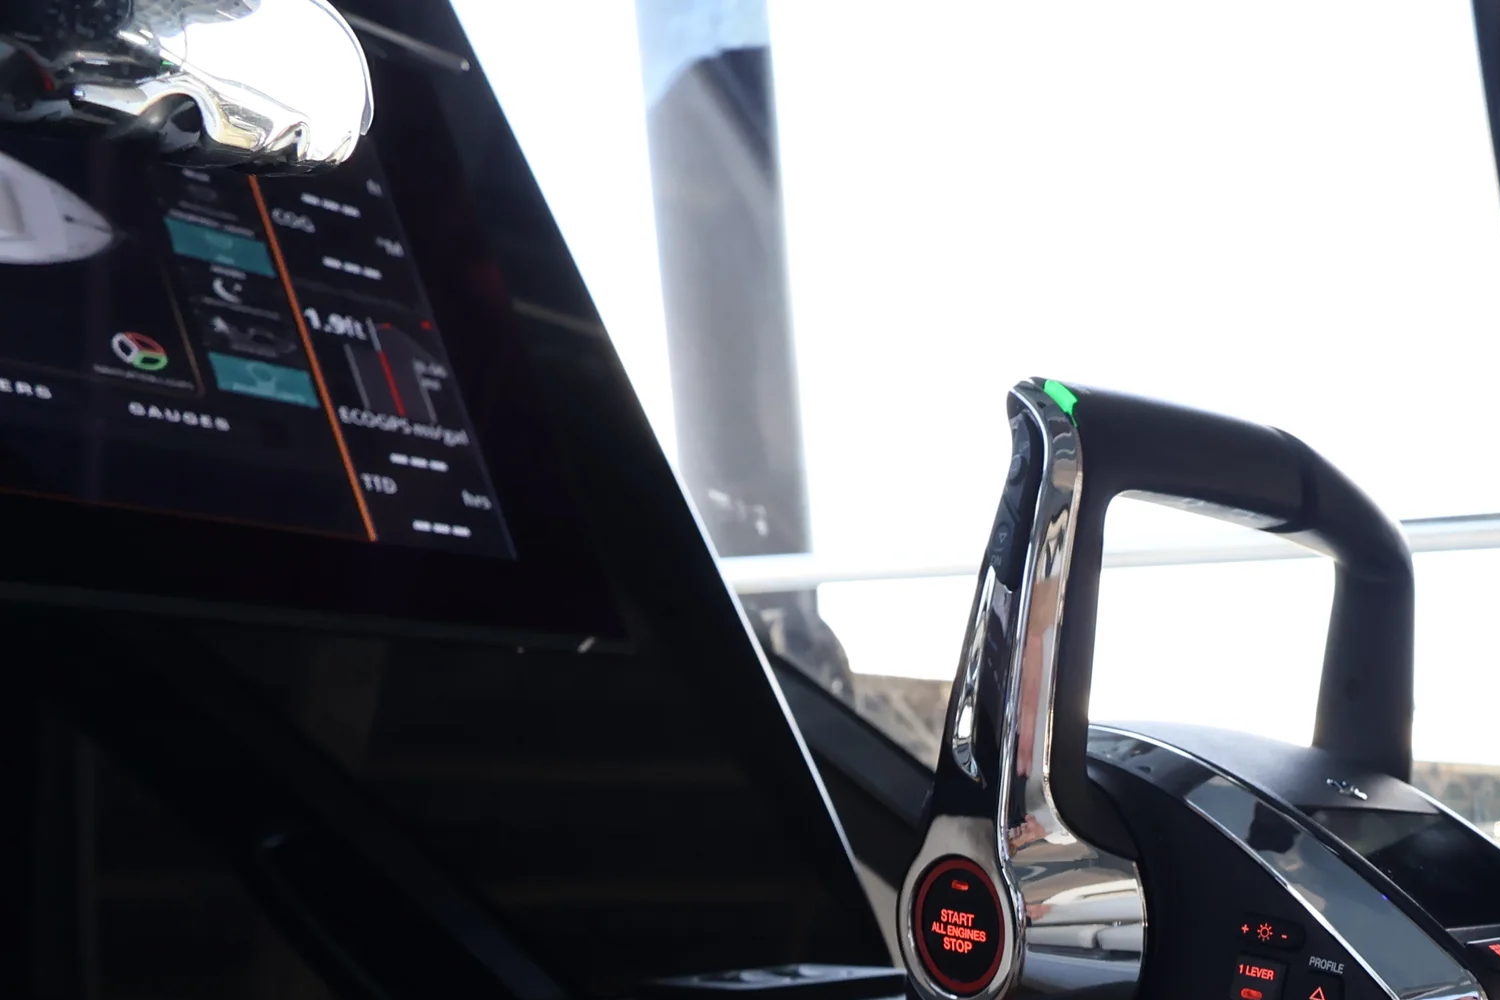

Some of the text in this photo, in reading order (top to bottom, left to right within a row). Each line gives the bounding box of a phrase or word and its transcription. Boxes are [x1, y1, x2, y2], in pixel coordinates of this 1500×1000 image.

[940, 908, 974, 927] START
[931, 921, 987, 942] ALL ENGINES
[943, 937, 973, 954] STOP
[1239, 964, 1275, 981] 1 LEVER
[1308, 956, 1345, 975] PROFILE
